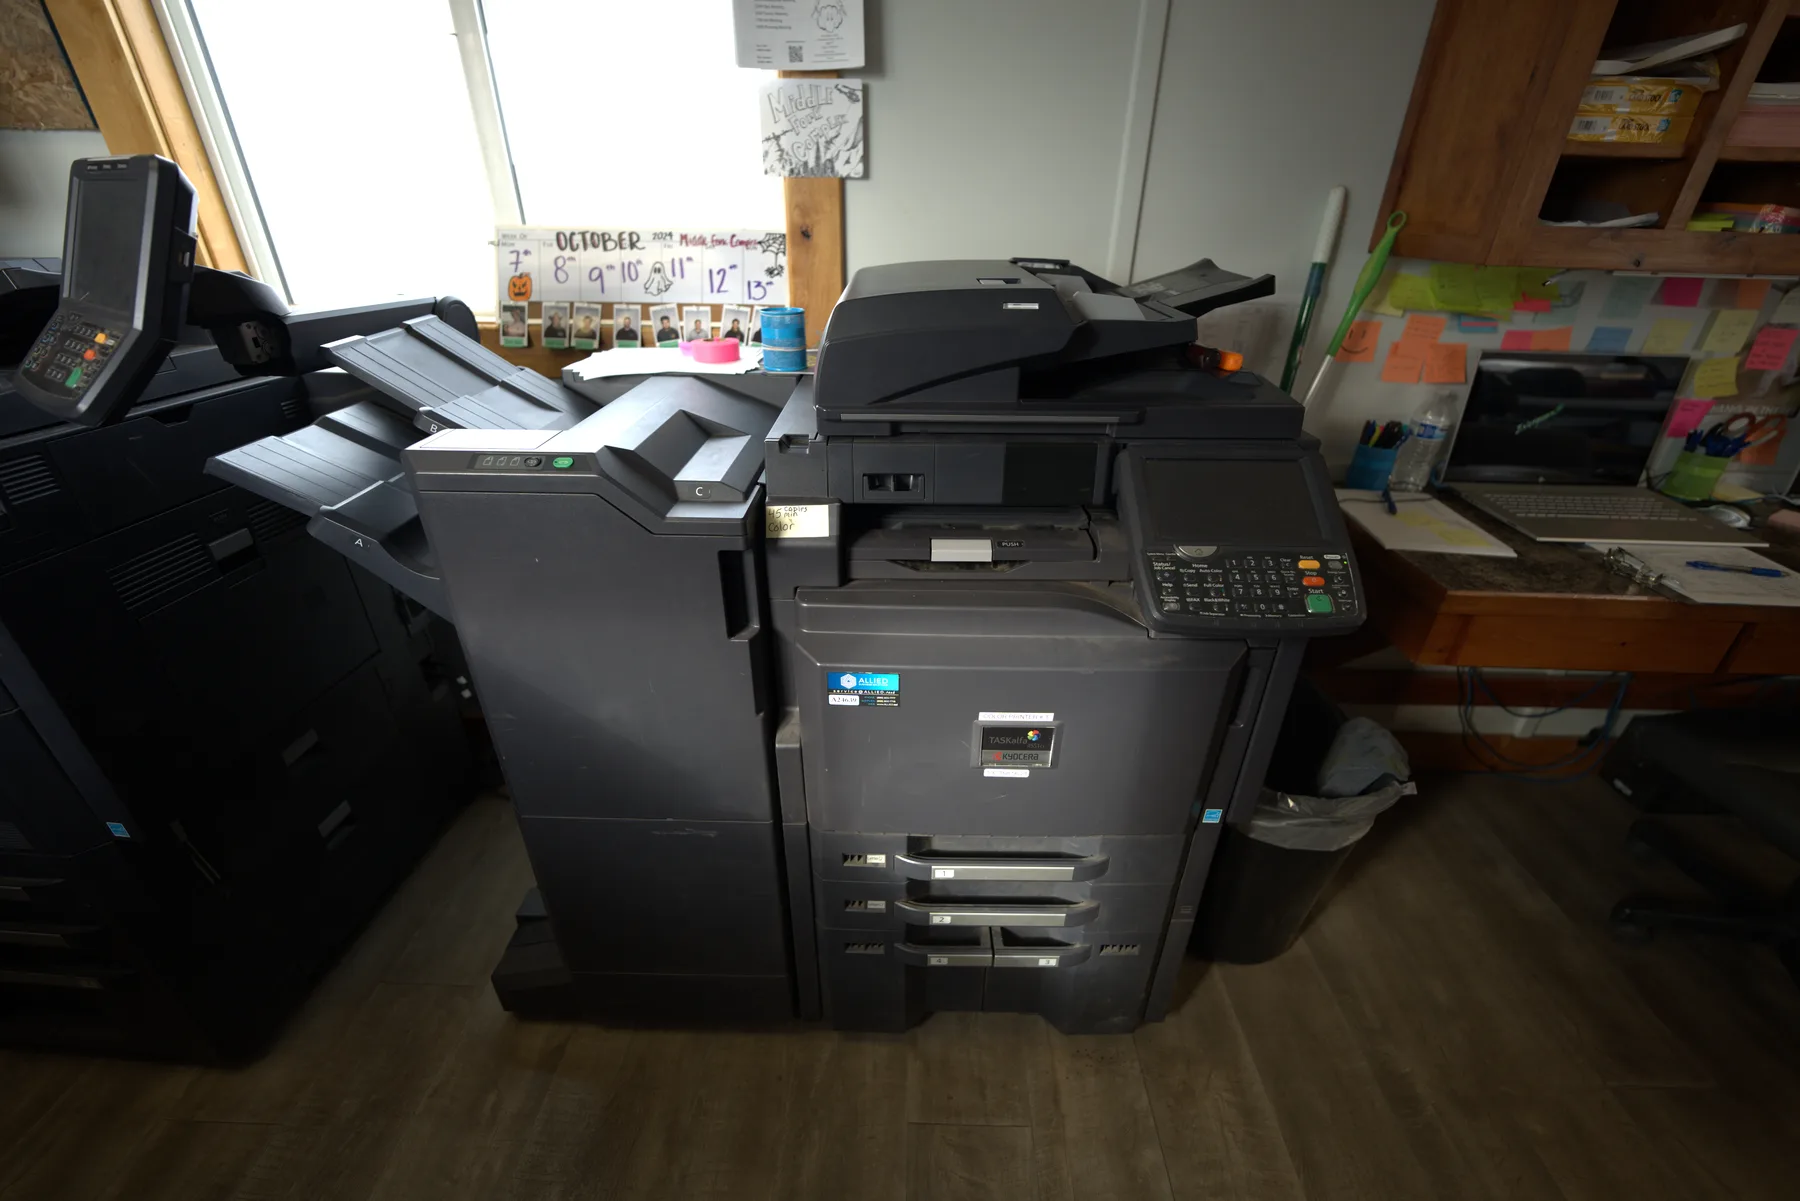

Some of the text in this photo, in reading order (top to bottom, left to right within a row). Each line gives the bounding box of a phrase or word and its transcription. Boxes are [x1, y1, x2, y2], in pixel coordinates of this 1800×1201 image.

[652, 231, 673, 241] 2024
[679, 233, 706, 247] Middle
[556, 231, 645, 252] OCTOBER
[429, 423, 439, 433] B
[695, 486, 703, 497] C
[768, 507, 782, 519] 45
[768, 521, 795, 533] Color
[354, 538, 364, 548] A
[1267, 559, 1274, 567] 3
[1253, 573, 1259, 581] 5
[1256, 588, 1263, 596] 8
[858, 677, 889, 685] ALLIED
[989, 736, 1028, 745] TASKalfa
[1002, 752, 1039, 761] KYOCERA
